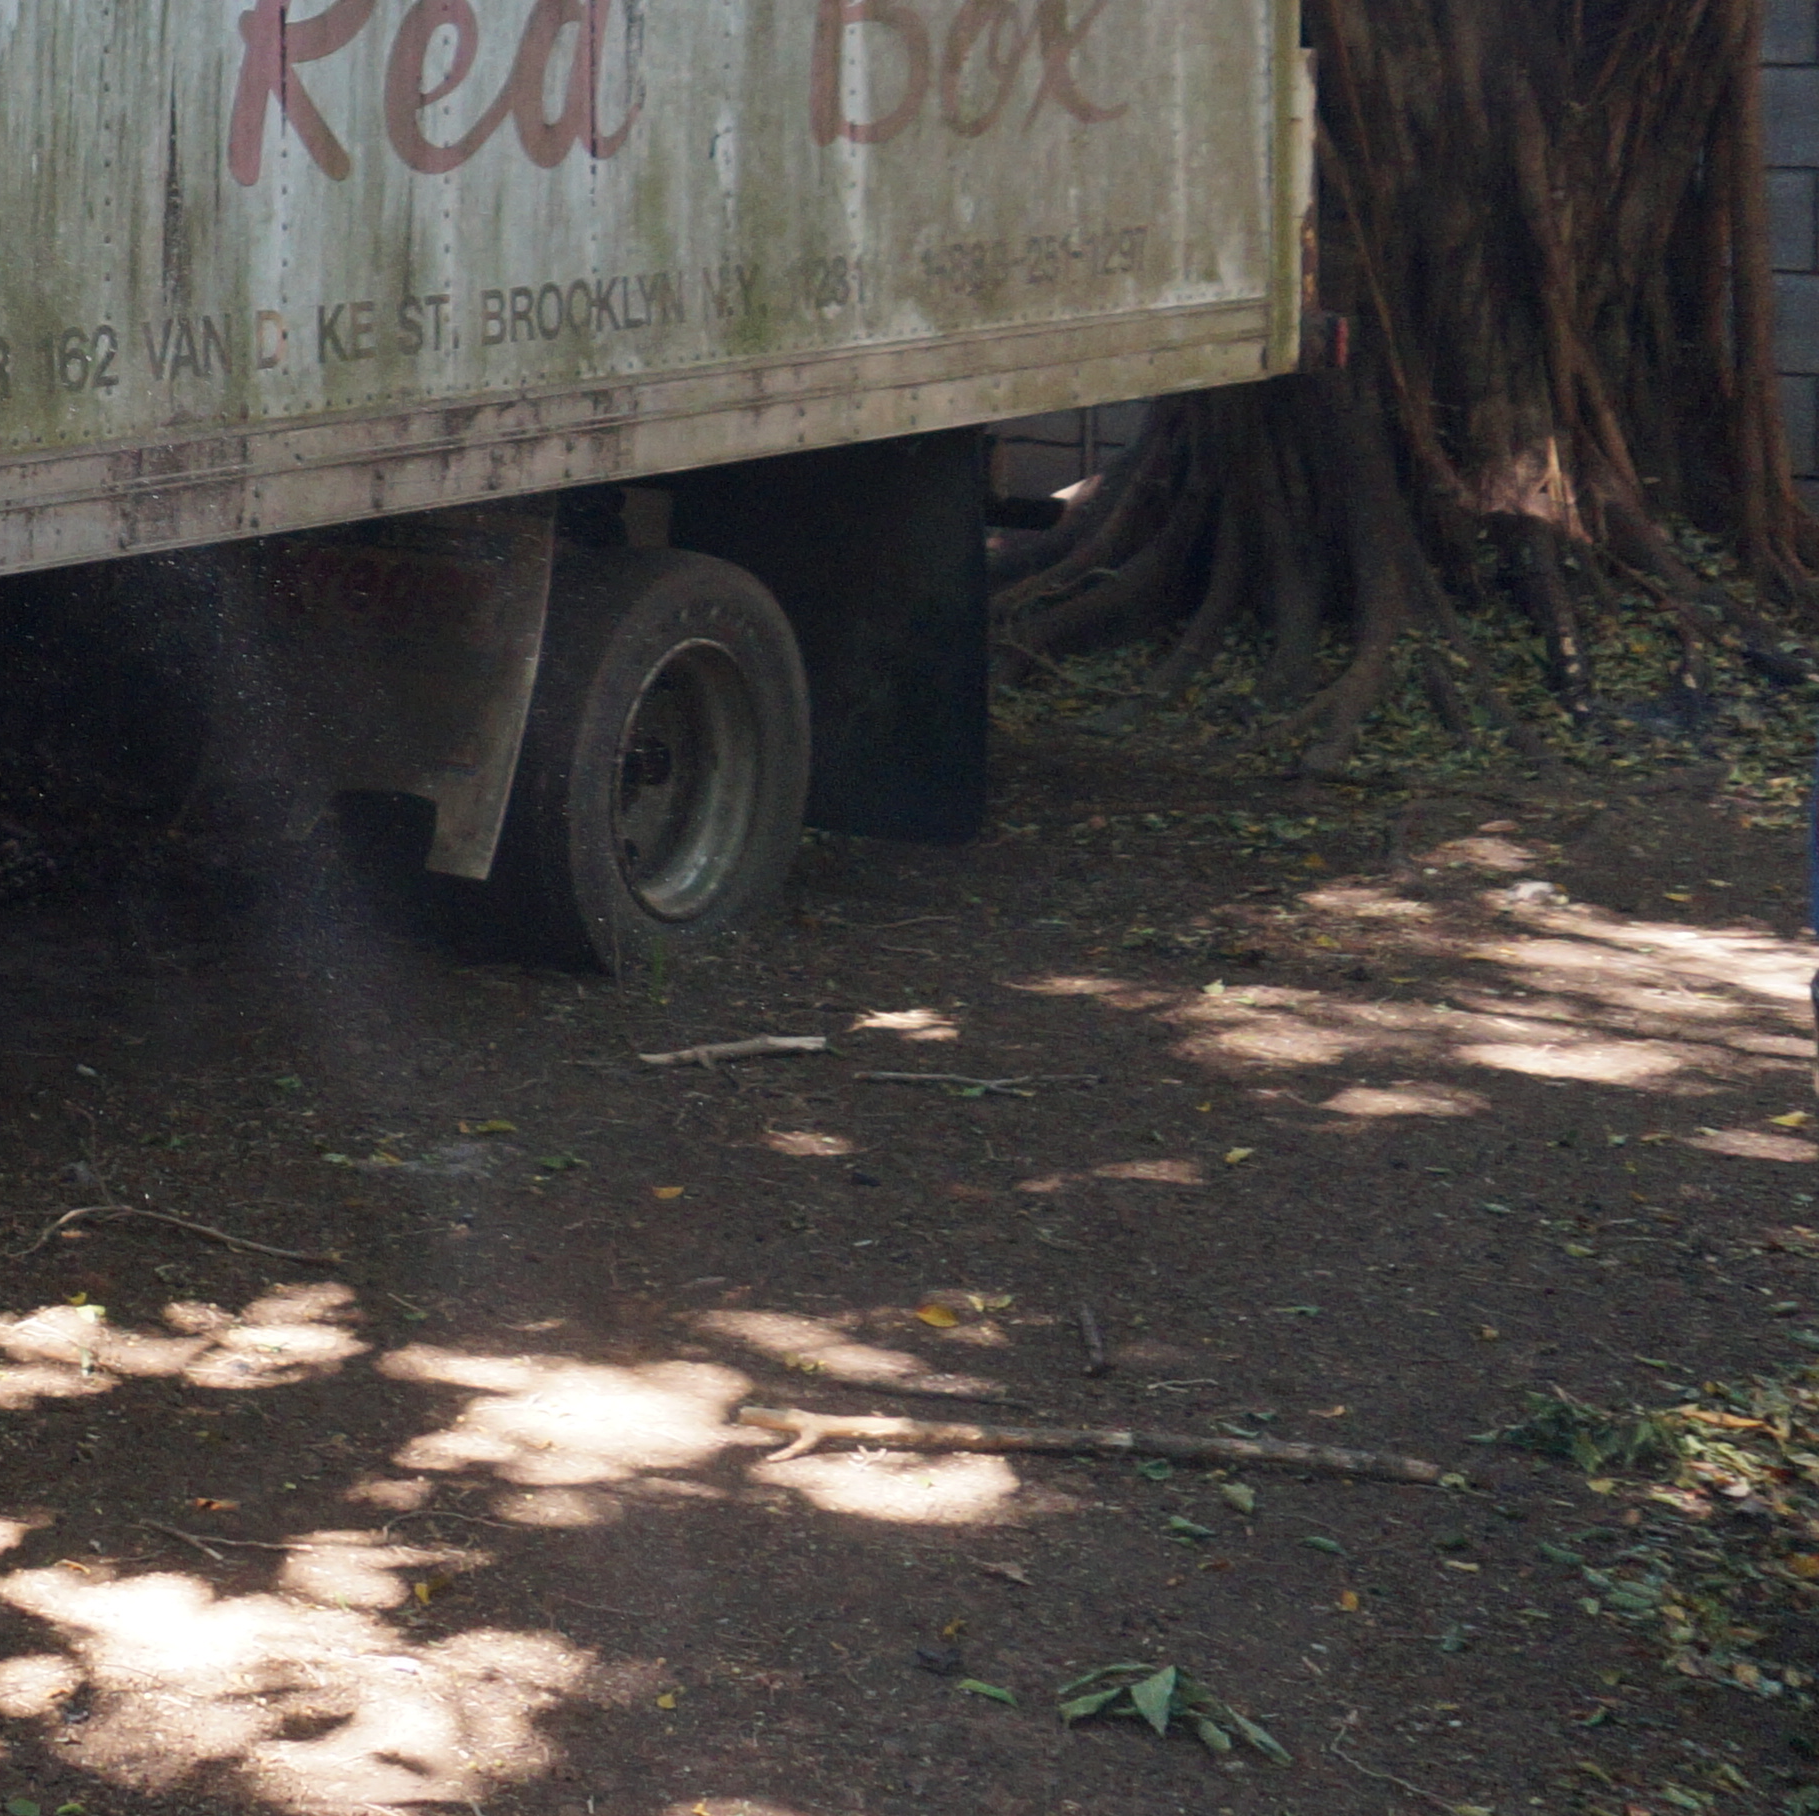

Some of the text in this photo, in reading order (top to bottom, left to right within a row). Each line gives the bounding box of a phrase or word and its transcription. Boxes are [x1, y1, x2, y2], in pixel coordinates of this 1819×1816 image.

[43, 325, 118, 389] 162
[142, 311, 232, 380] VAN
[256, 301, 376, 370] DKE
[481, 270, 684, 346] BROOKLYN
